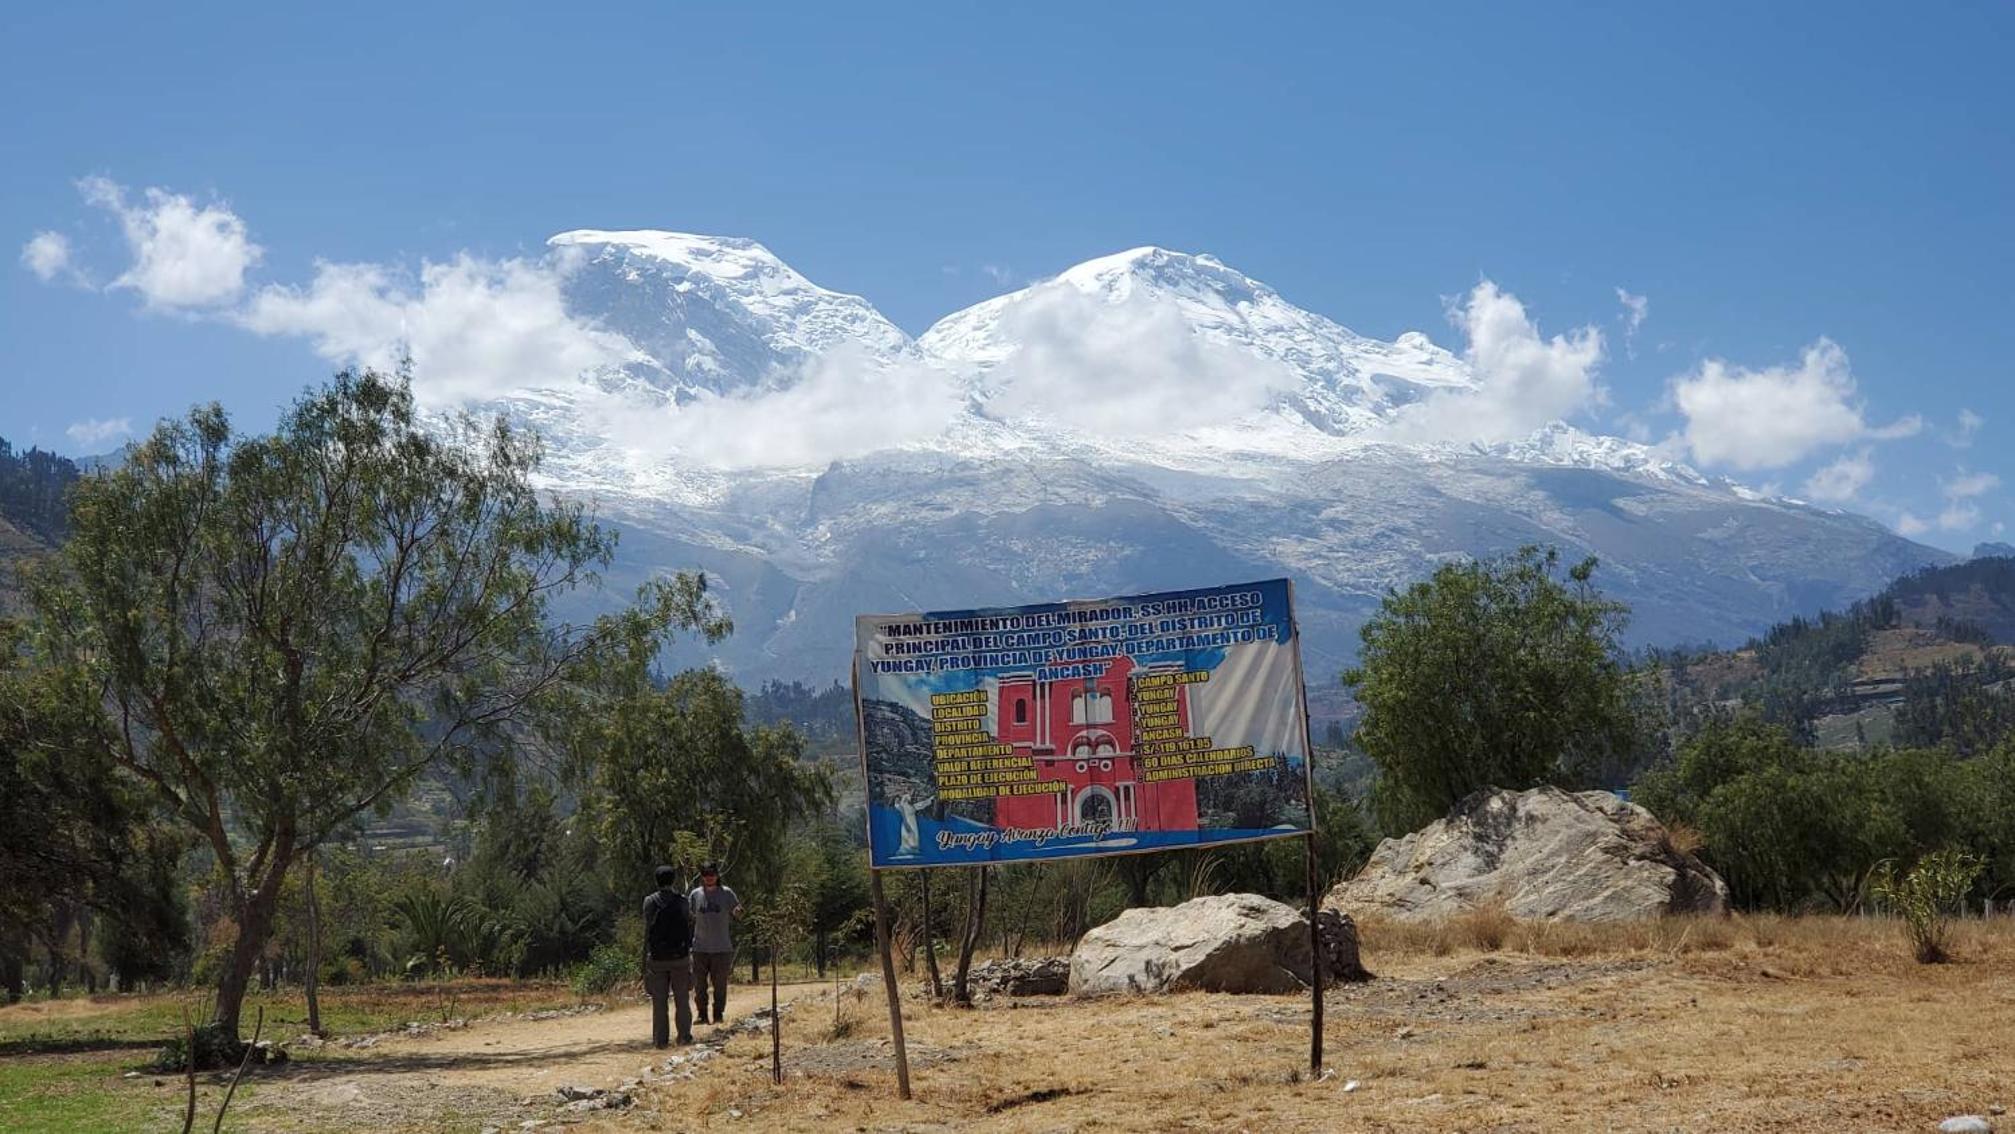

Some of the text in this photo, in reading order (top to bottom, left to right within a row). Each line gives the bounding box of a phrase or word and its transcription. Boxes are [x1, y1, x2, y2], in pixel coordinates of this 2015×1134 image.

[880, 616, 1020, 637] "MANTENIMIENTO
[1025, 614, 1053, 627] DEL
[1196, 591, 1262, 611] ACCESO
[884, 637, 970, 655] PRINCIPAL
[972, 636, 1000, 649] DEL
[1005, 631, 1062, 648] CAMPO
[1128, 622, 1157, 636] DEL
[1160, 612, 1235, 632] DISTRITO
[1239, 610, 1261, 625] DE
[938, 652, 1029, 670] PROVINCIA
[1032, 650, 1053, 663] DE
[1125, 629, 1253, 654] DEPARTAMENTO
[1256, 625, 1277, 641] DE
[1037, 661, 1112, 681] ANCASH"
[1138, 671, 1209, 688] CAMPO SANTO
[932, 690, 987, 705] UBICACIÓN
[1138, 688, 1175, 701] YUNGAY
[933, 704, 986, 718] LOCALIDAD
[1140, 702, 1178, 714] YUNGAY
[934, 720, 980, 732] DISTRITO
[1141, 714, 1179, 727] YUNGAY
[935, 732, 989, 745] PROVINCIA
[1142, 727, 1183, 740] ANCASH
[936, 744, 1013, 759] DEPARTAMENTO
[1185, 746, 1253, 763] CALENDARIOS
[937, 757, 1034, 773] VALOR REFERENCIAL
[1234, 757, 1275, 771] DIRECTA
[938, 768, 1037, 786] PLAZO DE EJECUCIÓN
[939, 780, 1066, 799] MODALIDAD DE EJECUCIÓN
[937, 830, 997, 850] Yungay
[1001, 827, 1055, 845] Avanza
